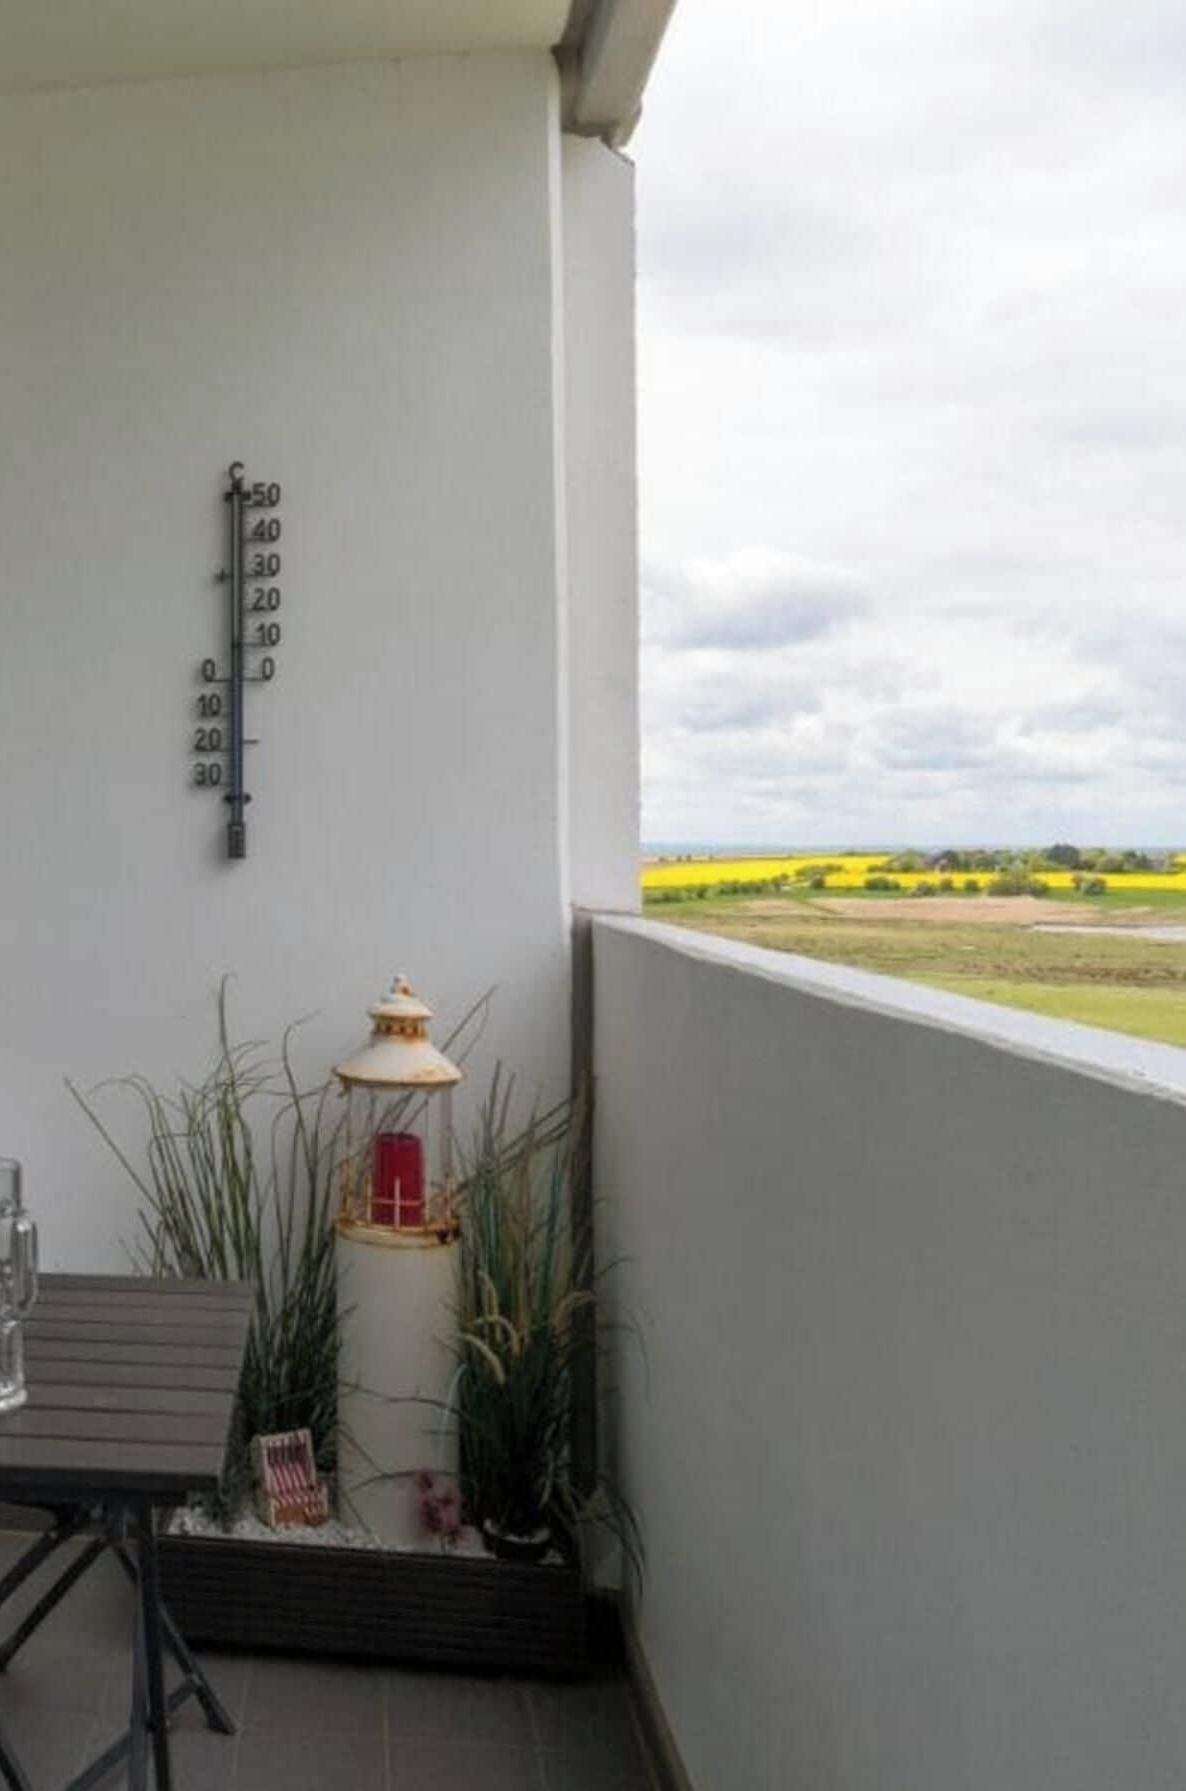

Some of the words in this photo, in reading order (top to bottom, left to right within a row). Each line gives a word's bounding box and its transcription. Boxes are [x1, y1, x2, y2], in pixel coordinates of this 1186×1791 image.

[252, 482, 281, 508] 50
[252, 518, 281, 543] 40
[252, 553, 281, 577] 30
[252, 587, 281, 611] 20
[255, 622, 281, 646] 10
[196, 693, 222, 718] 10
[194, 727, 222, 752] 20
[193, 762, 222, 787] 30
